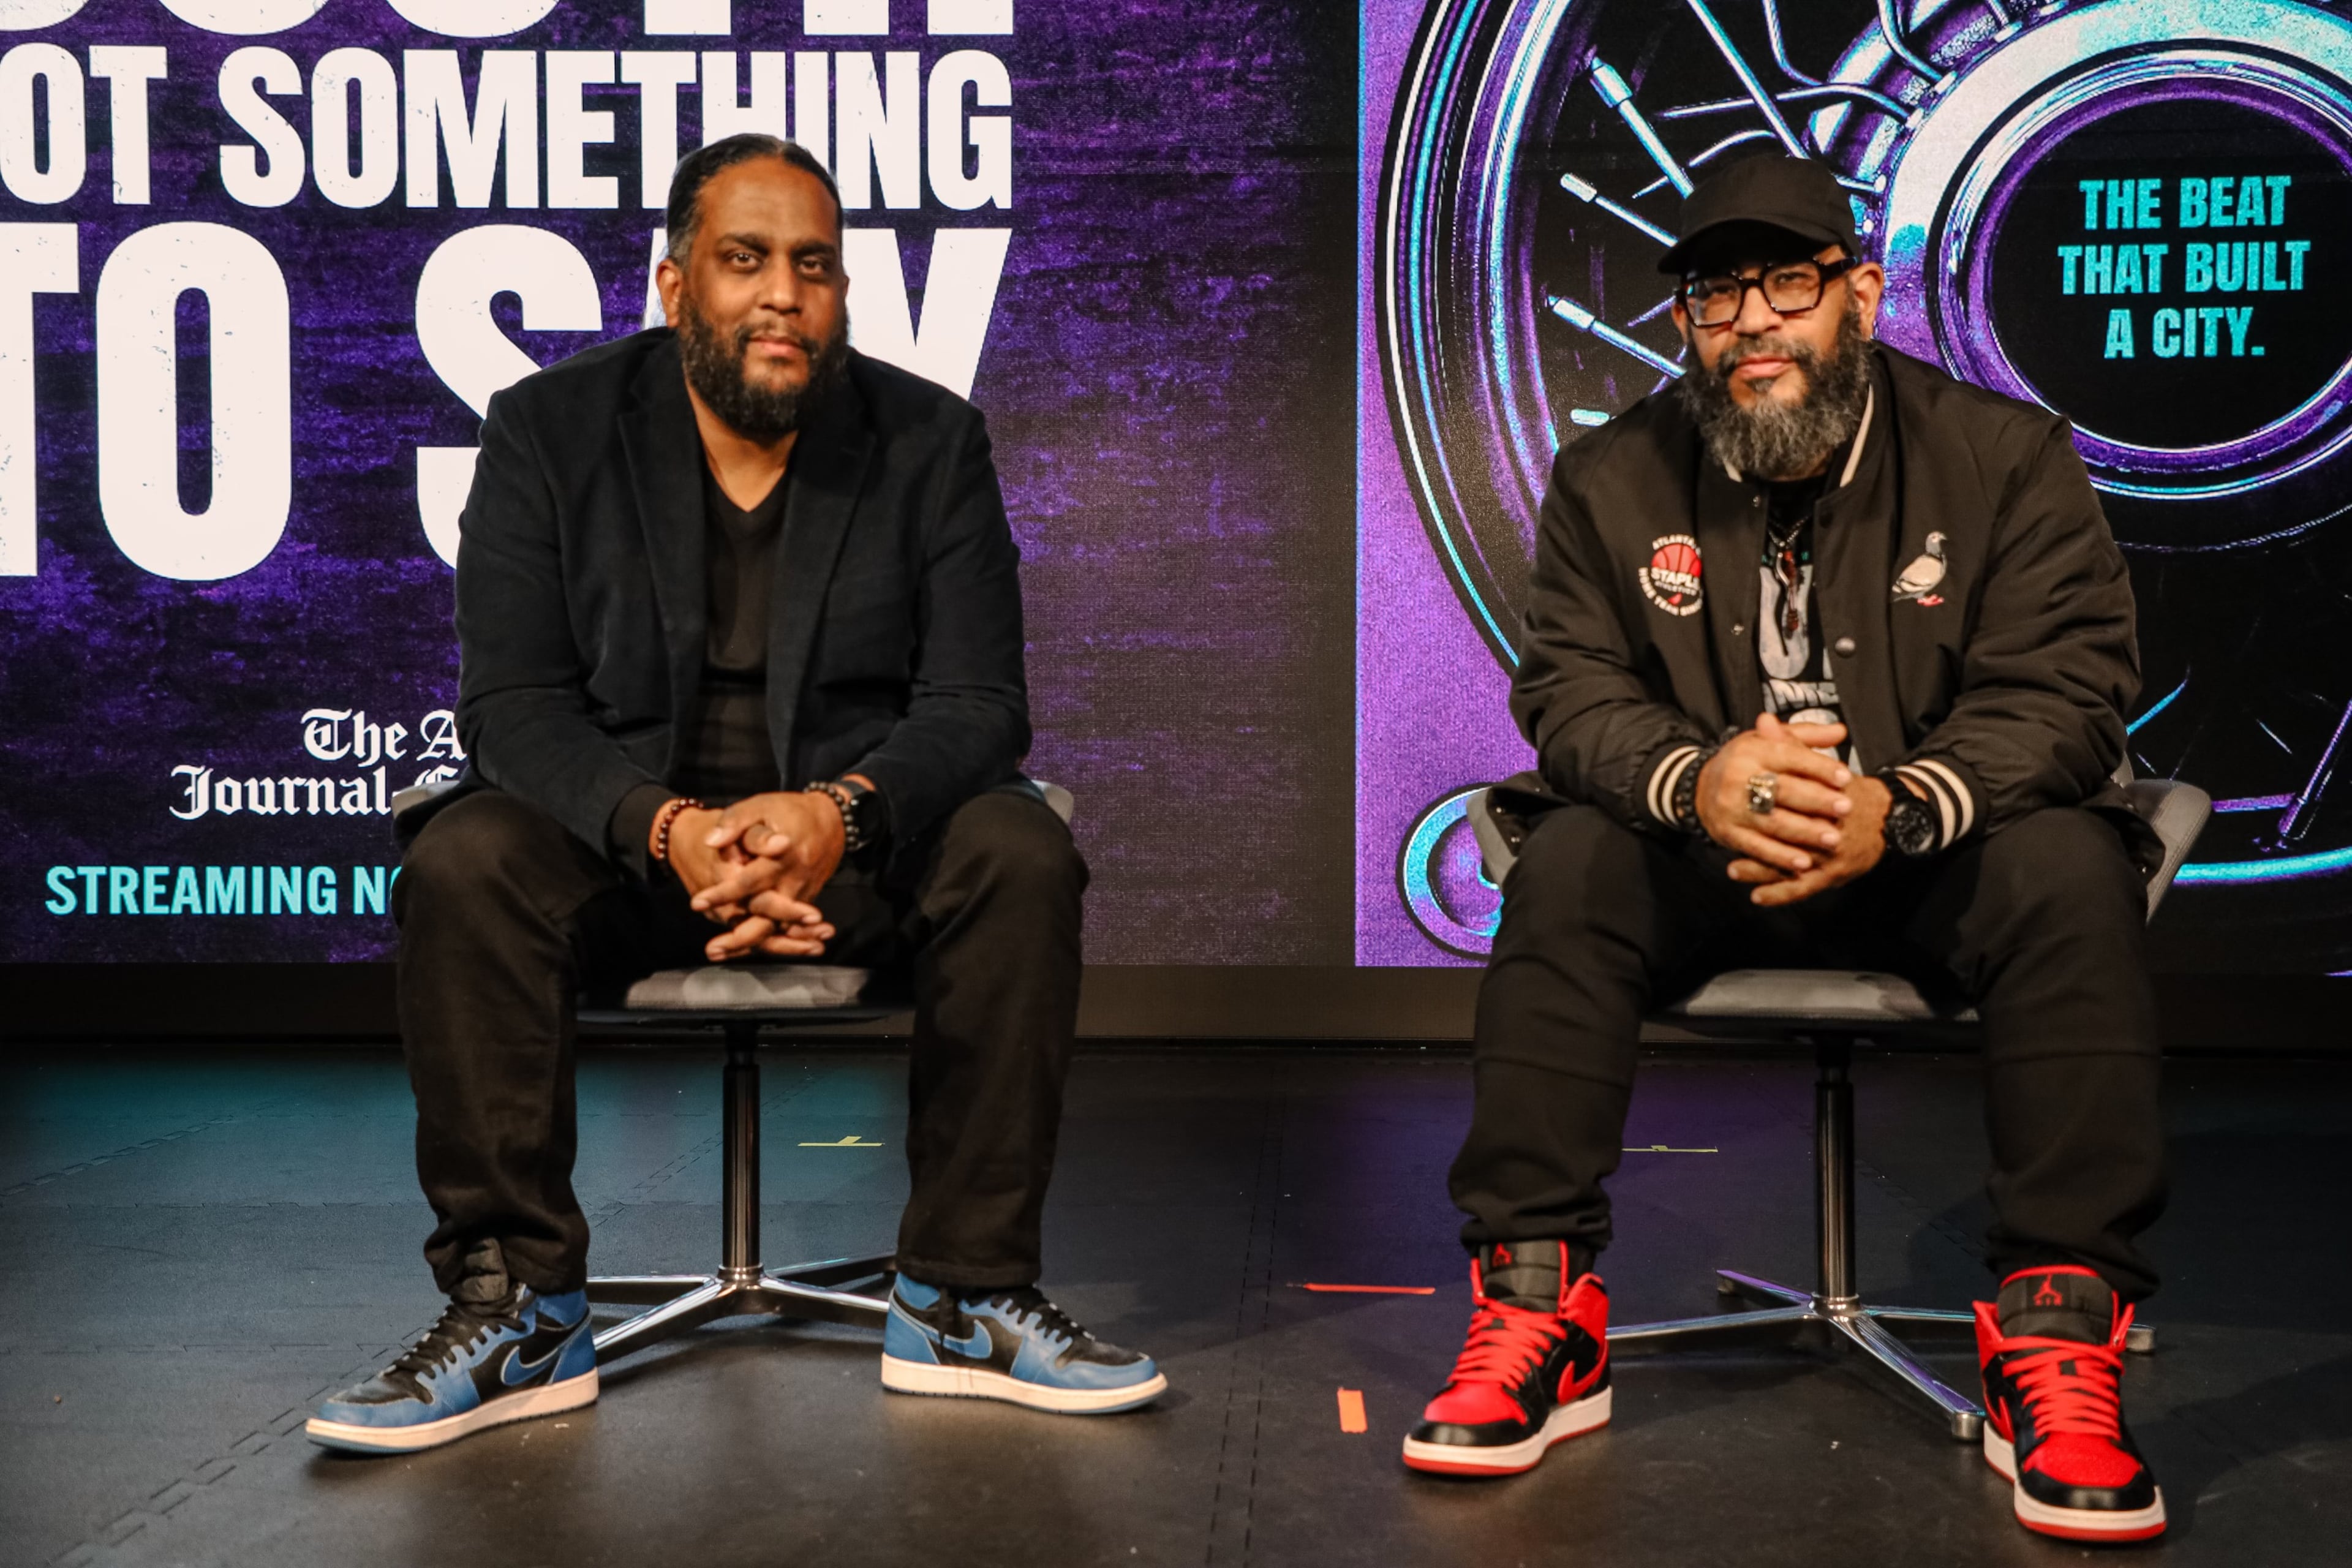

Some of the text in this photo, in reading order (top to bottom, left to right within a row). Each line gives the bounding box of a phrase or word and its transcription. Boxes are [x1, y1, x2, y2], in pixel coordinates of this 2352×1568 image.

[218, 45, 1012, 211] SOMETHING
[2079, 175, 2291, 230] THE BEAT
[2057, 240, 2310, 295] THAT BUILT
[2104, 306, 2265, 359] A CITY.
[415, 224, 1012, 579] SY
[1651, 567, 1700, 592] STAPLE
[301, 708, 408, 767] The
[45, 865, 402, 915] STREAMING N
